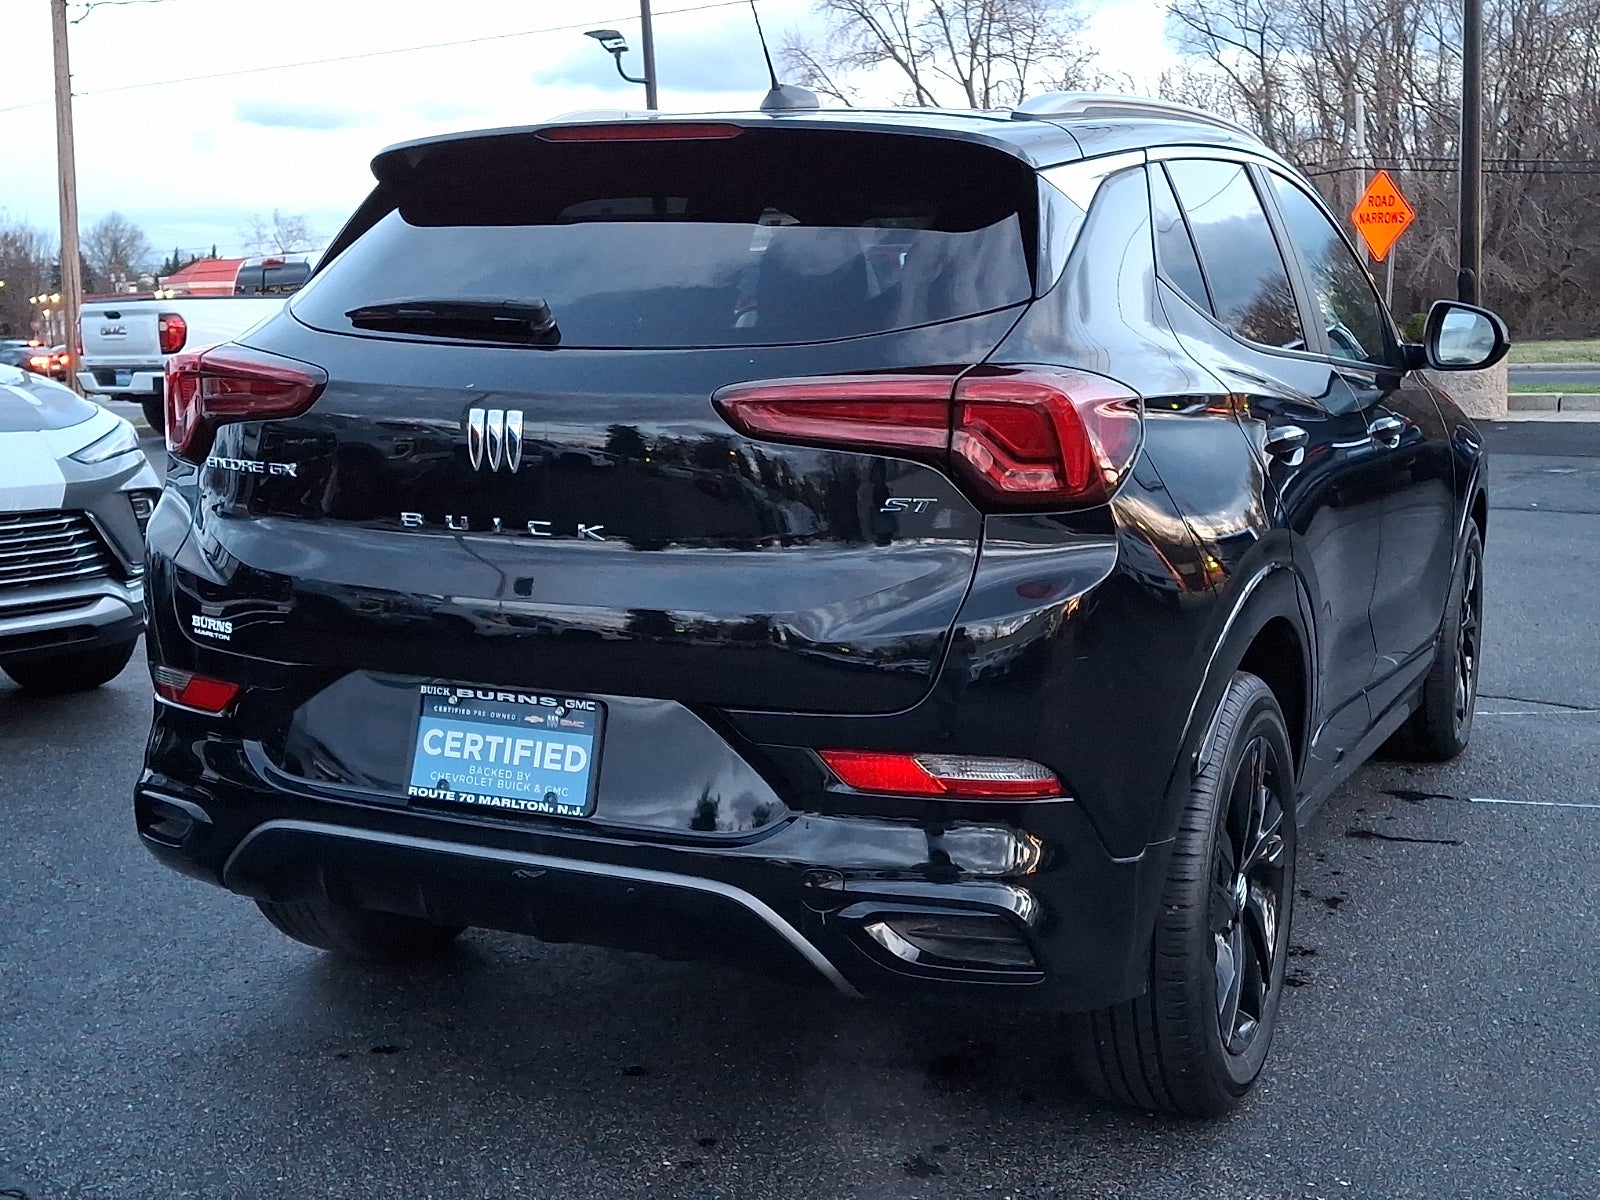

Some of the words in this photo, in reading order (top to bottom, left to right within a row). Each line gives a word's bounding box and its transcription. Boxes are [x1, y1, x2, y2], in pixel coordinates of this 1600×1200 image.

[1368, 195, 1395, 207] ROAD
[1359, 211, 1405, 224] NARROWS
[206, 457, 265, 473] ENCORE
[268, 462, 298, 478] GX
[880, 497, 938, 513] ST
[400, 512, 605, 541] BUICK
[191, 615, 233, 633] BURNS
[193, 628, 231, 641] MARLTON
[420, 685, 450, 696] BUICK
[456, 688, 558, 707] BURNS
[565, 699, 596, 711] GMC
[433, 705, 471, 715] CERTIFIED
[560, 719, 584, 728] GMC
[423, 728, 588, 773] CERTIFIED
[469, 765, 512, 779] BACKED
[516, 771, 531, 781] BY
[430, 771, 493, 787] CHEVROLET
[497, 779, 531, 792] BUICK
[533, 783, 541, 794] &
[544, 785, 569, 797] GMC
[408, 786, 455, 801] ROUTE
[459, 792, 475, 803] 70
[478, 795, 554, 813] MARLTON,
[556, 804, 584, 816] N.J.
